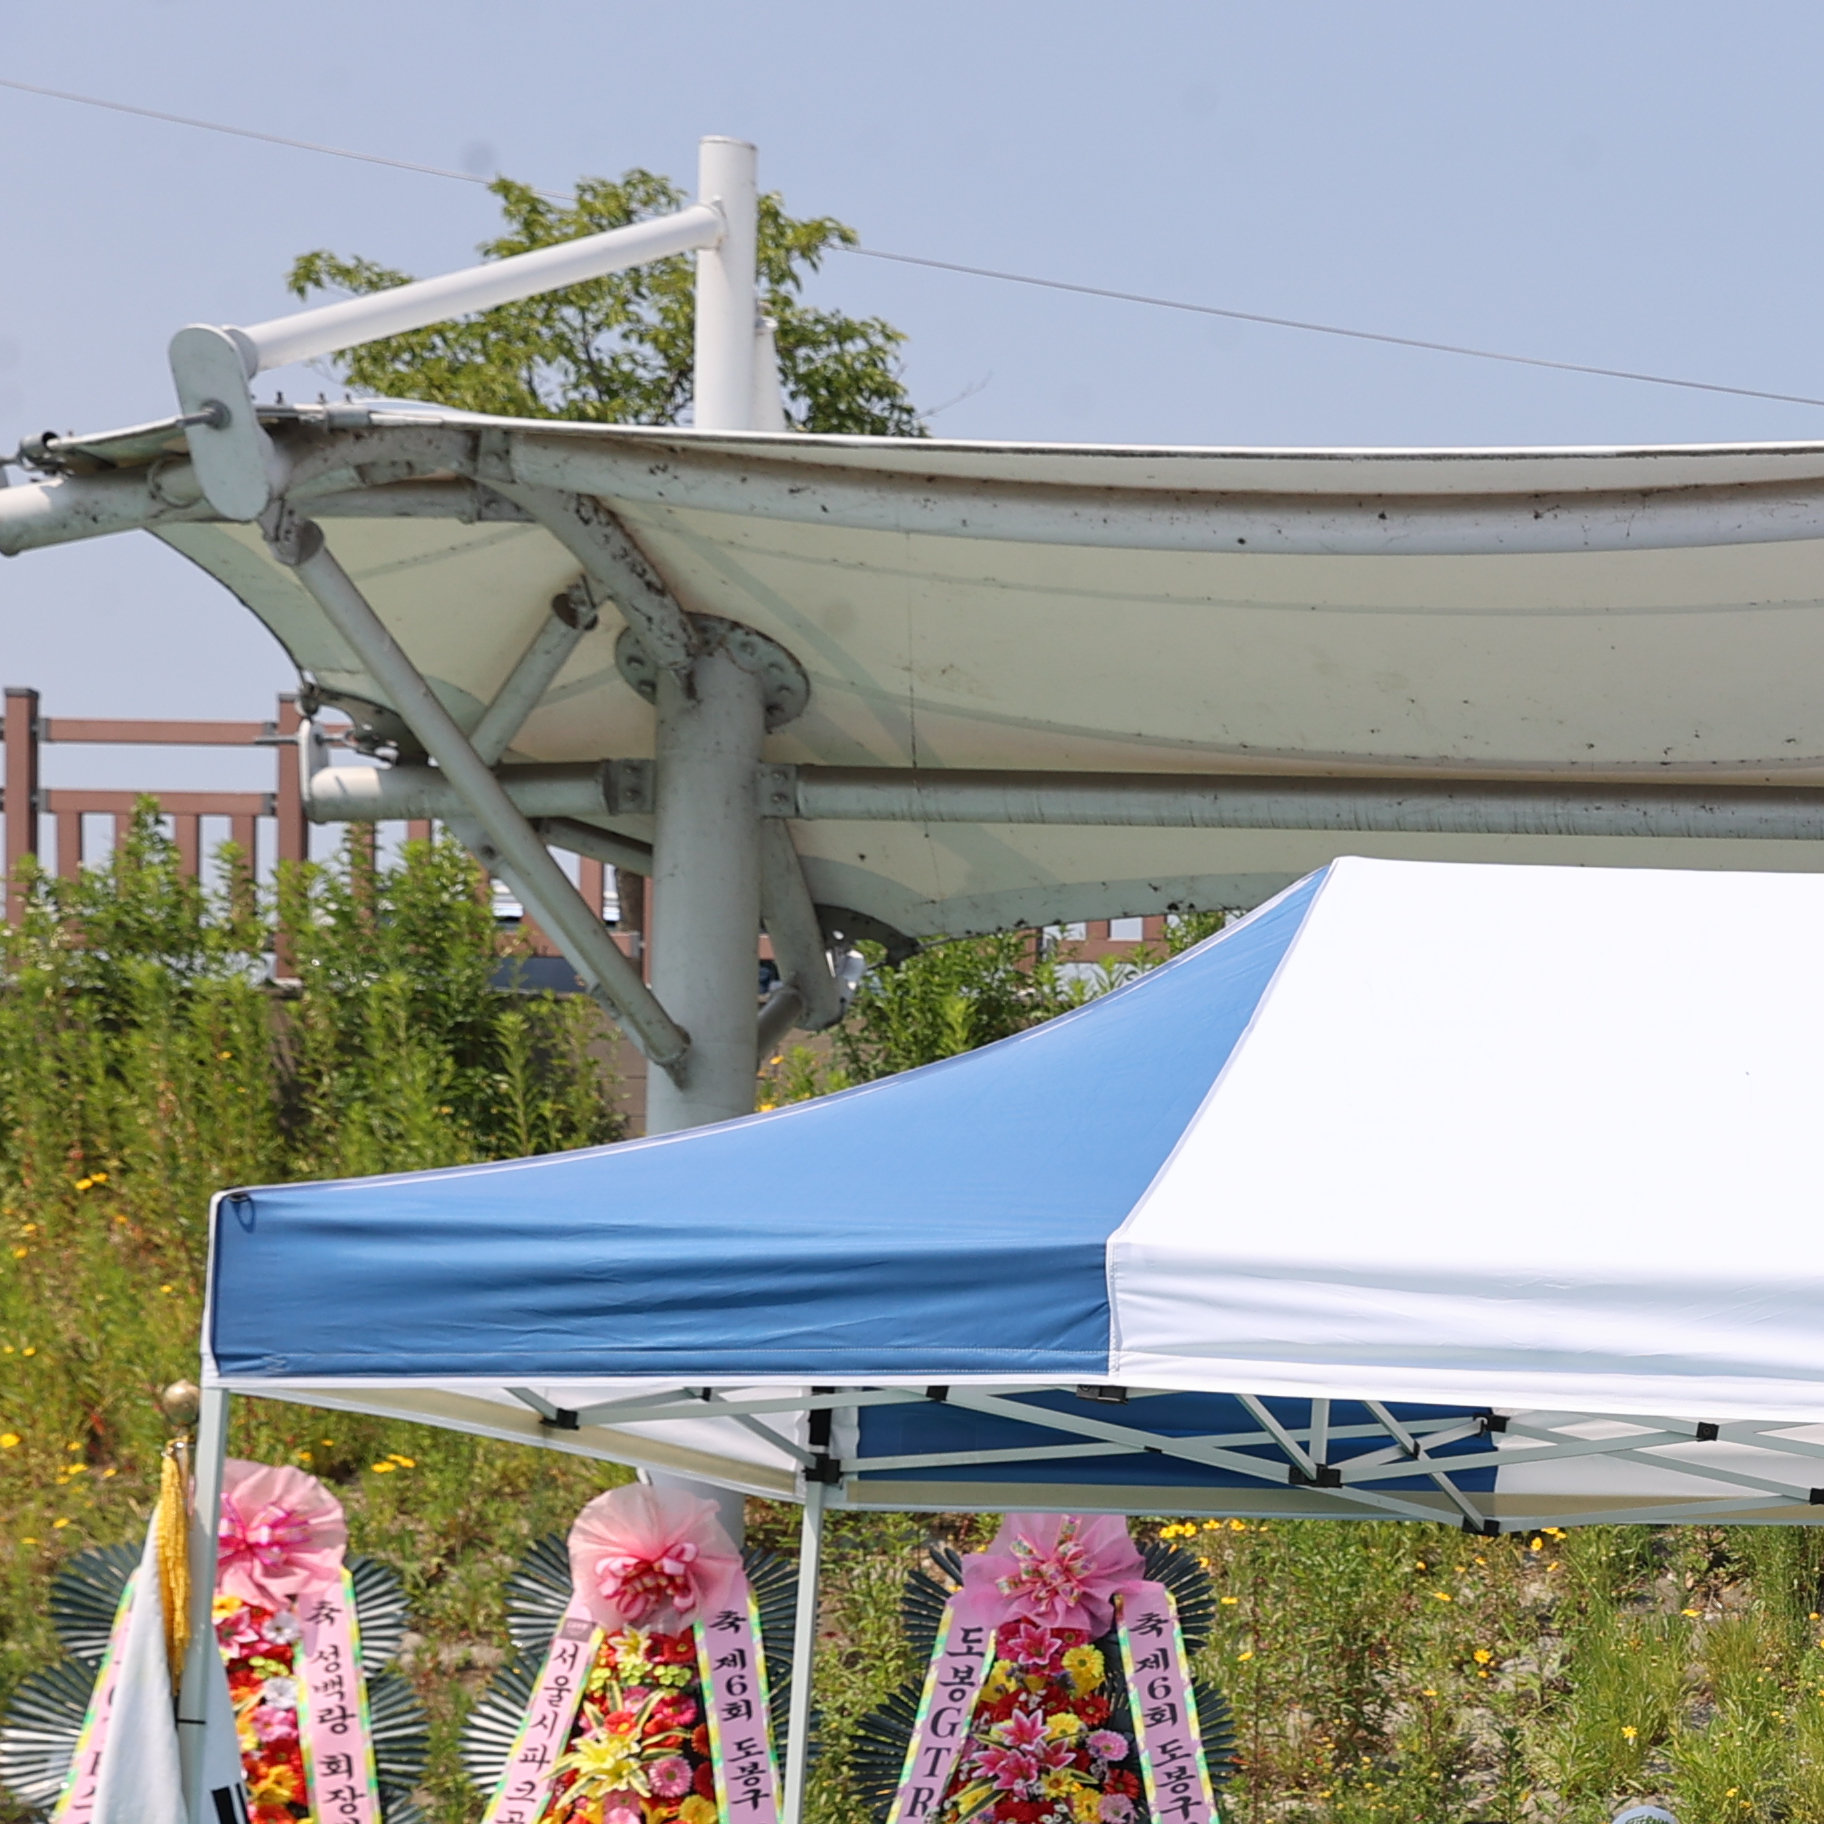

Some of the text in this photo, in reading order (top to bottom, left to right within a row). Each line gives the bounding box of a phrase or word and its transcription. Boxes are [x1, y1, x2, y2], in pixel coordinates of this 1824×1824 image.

[708, 1609, 747, 1635] 축
[1129, 1611, 1169, 1638] 축
[310, 1643, 357, 1736] 성백랑
[714, 1649, 755, 1723] 제6회
[1134, 1647, 1179, 1729] 제6회
[725, 1737, 773, 1813] 도봉구
